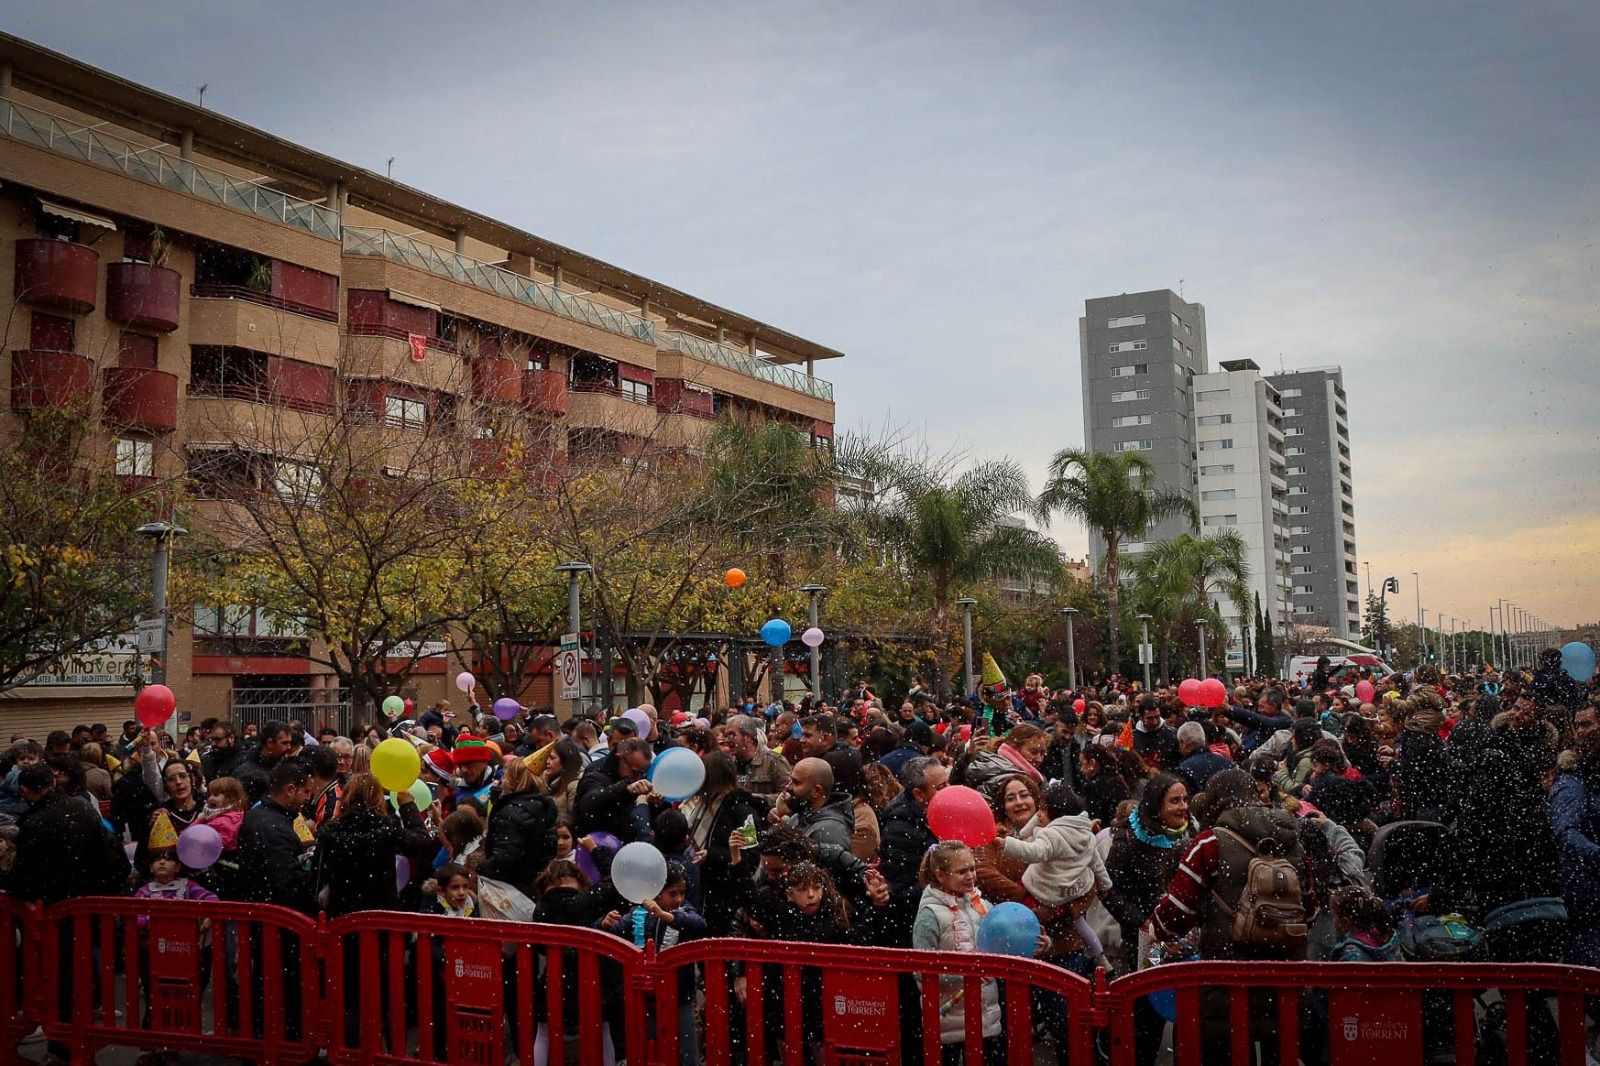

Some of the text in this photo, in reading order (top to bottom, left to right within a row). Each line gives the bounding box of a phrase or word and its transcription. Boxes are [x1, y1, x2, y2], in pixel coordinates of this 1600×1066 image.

[464, 969, 492, 979] TORRENT
[847, 1006, 886, 1016] TORRENT
[1361, 1029, 1408, 1040] TORRENT
